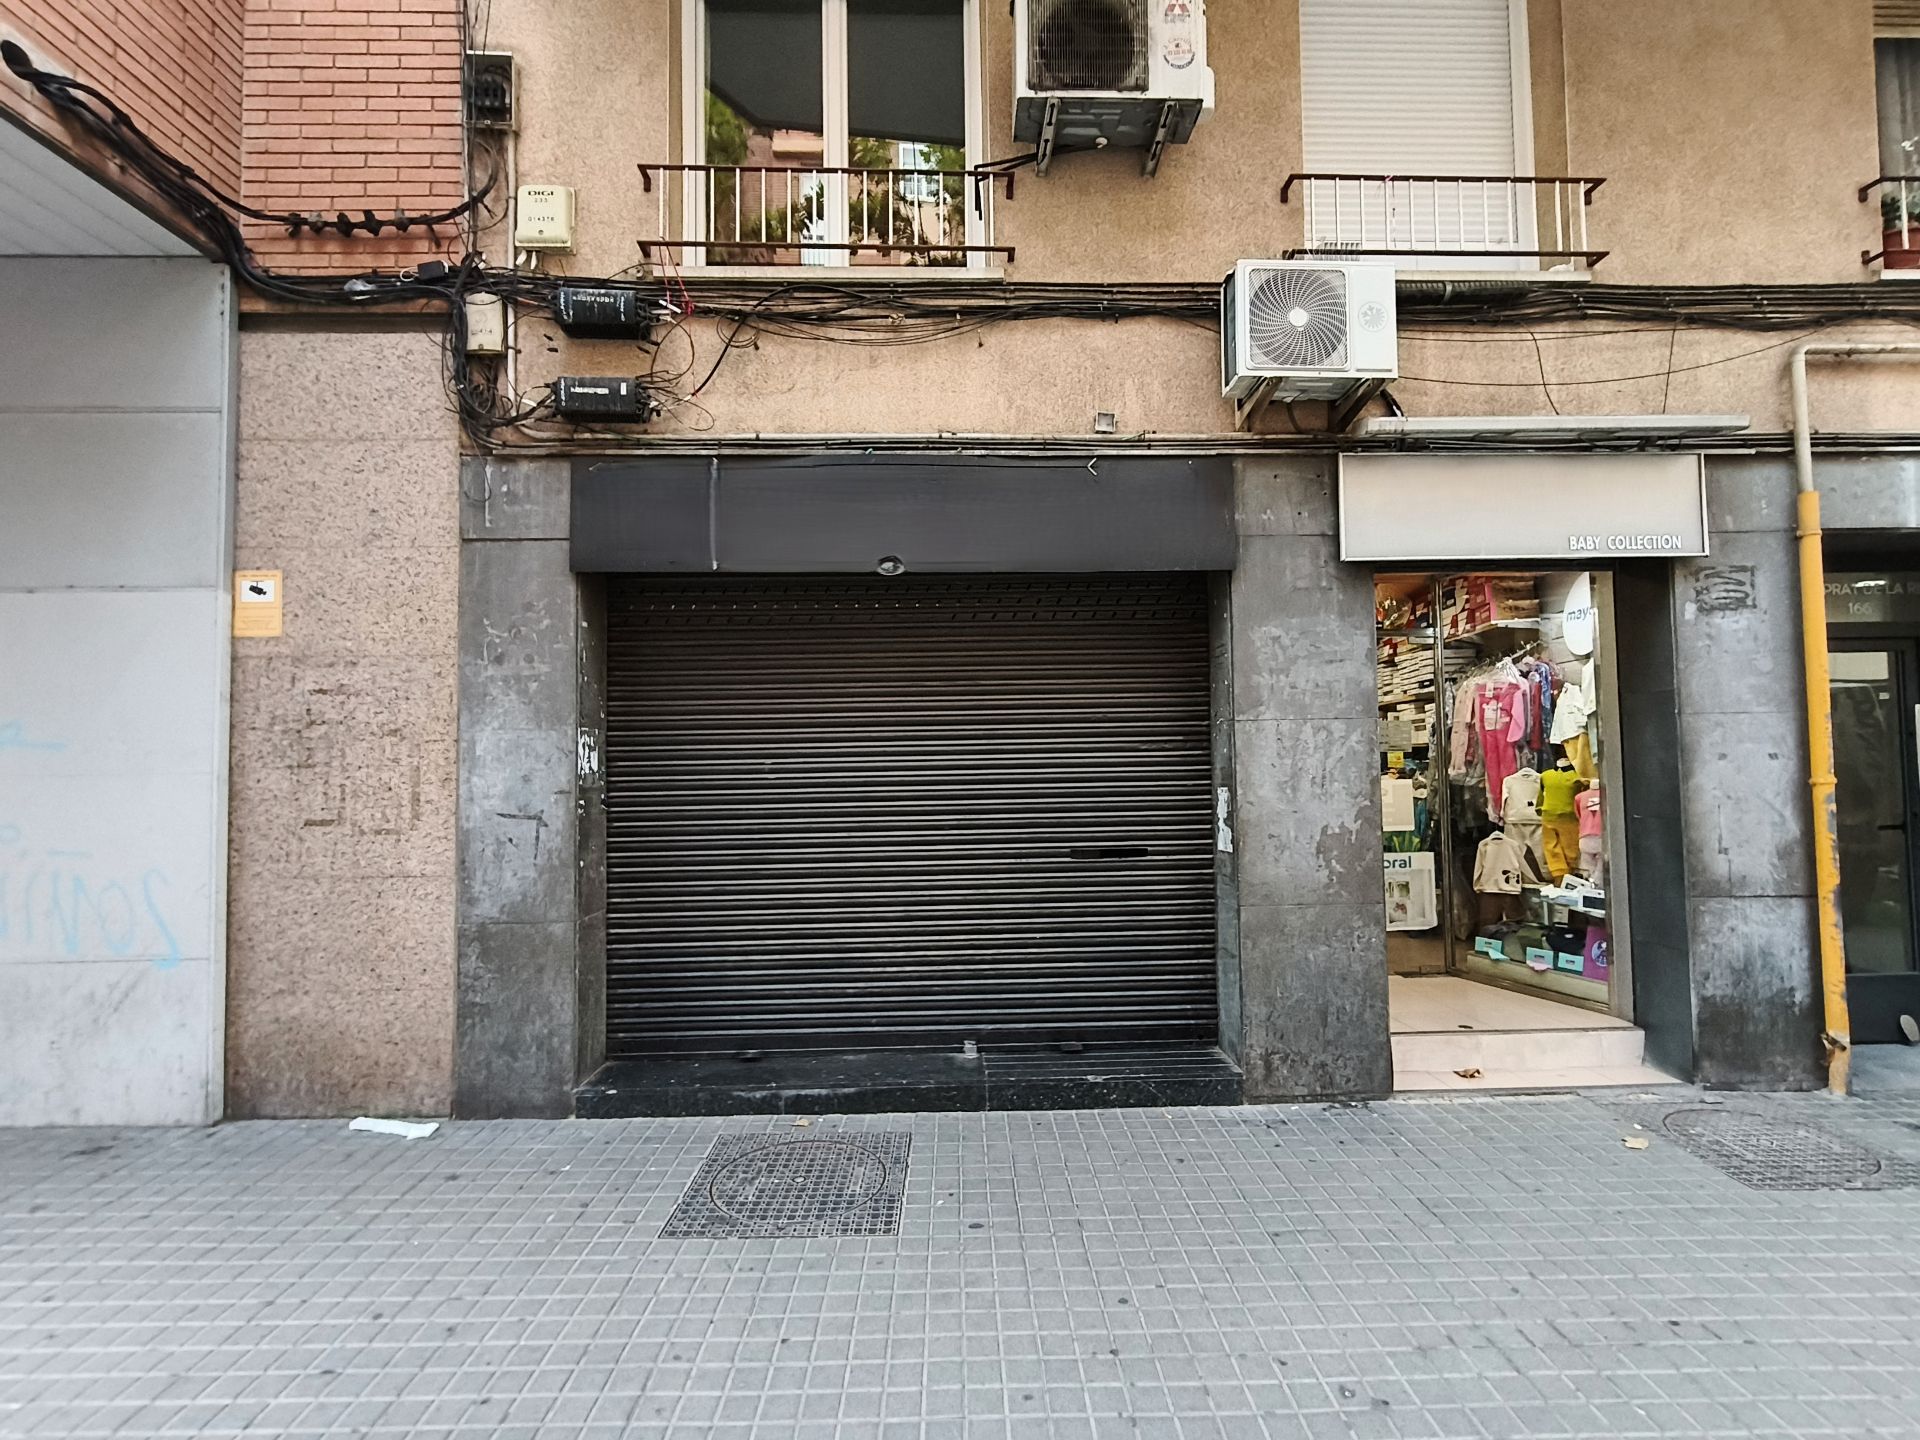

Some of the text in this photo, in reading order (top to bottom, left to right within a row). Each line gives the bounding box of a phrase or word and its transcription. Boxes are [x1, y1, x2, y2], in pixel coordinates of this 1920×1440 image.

[1569, 534, 1682, 550] BABY COLLECTION
[1886, 582, 1904, 594] LA
[1566, 607, 1592, 622] may
[1848, 602, 1873, 615] 166
